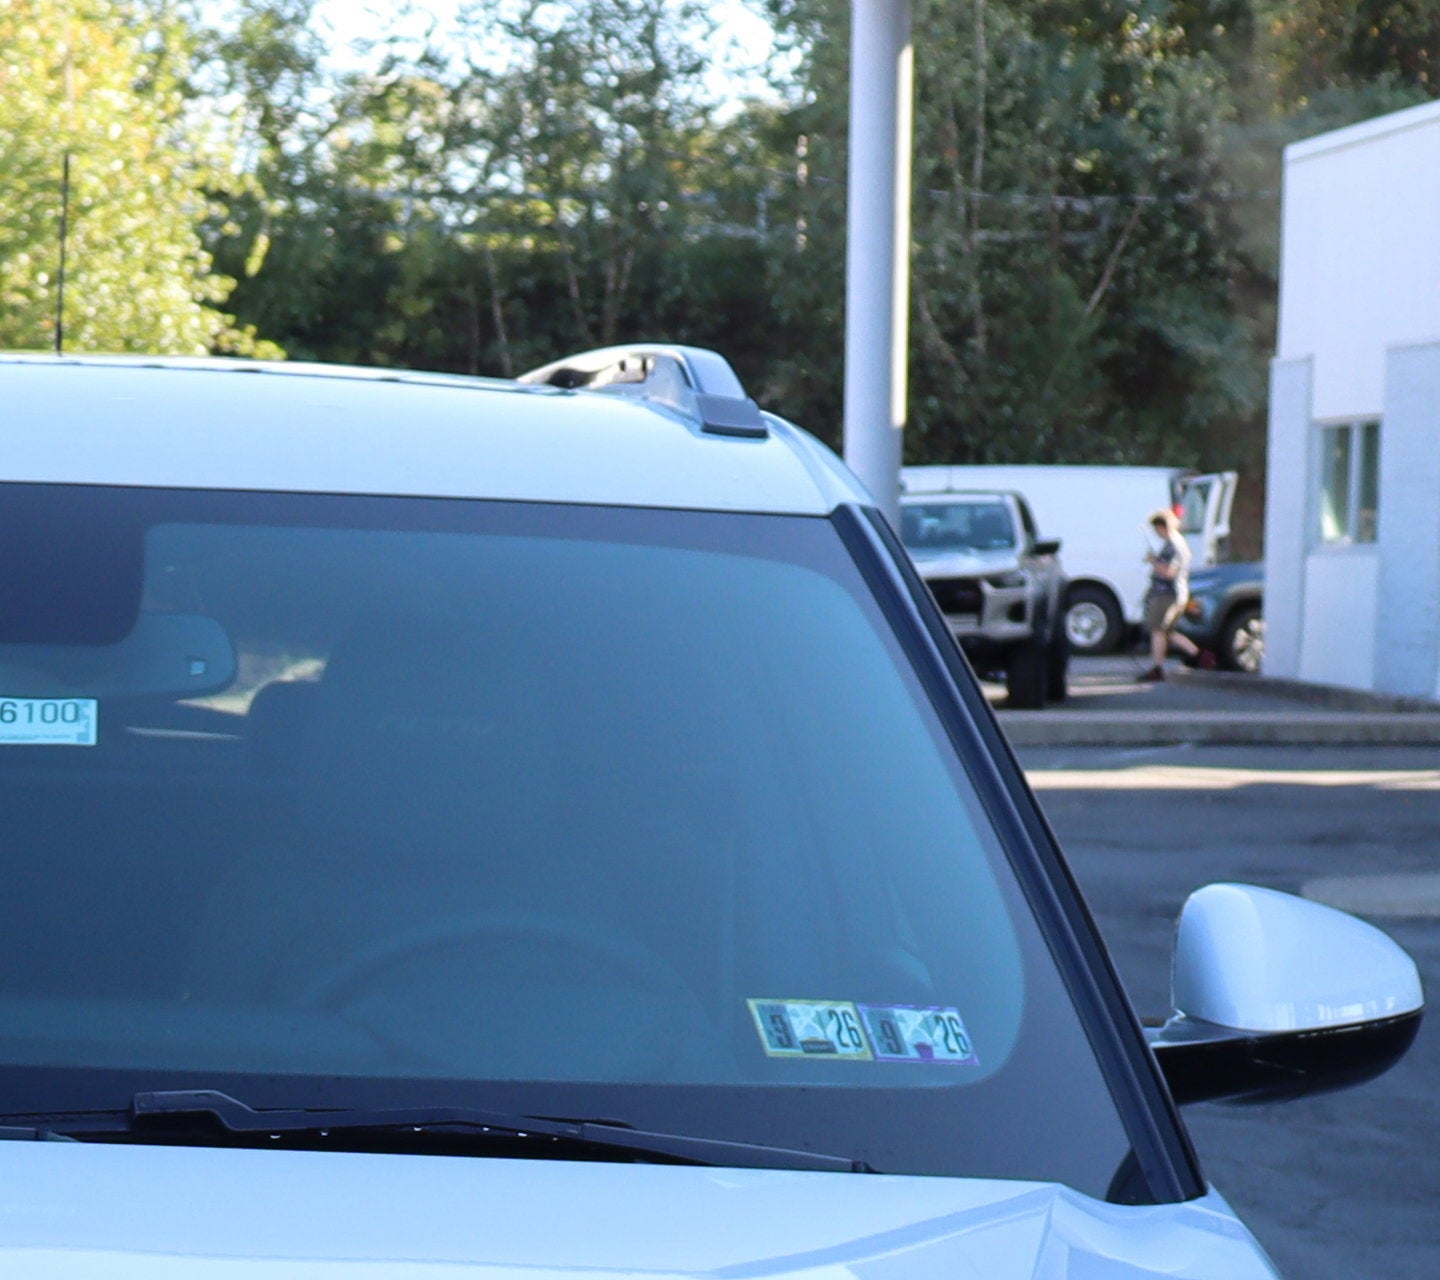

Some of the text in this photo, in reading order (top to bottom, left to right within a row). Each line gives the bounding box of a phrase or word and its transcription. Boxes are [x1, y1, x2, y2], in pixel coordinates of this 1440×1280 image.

[827, 1009, 863, 1049] 26
[879, 1014, 971, 1055] 9 26
